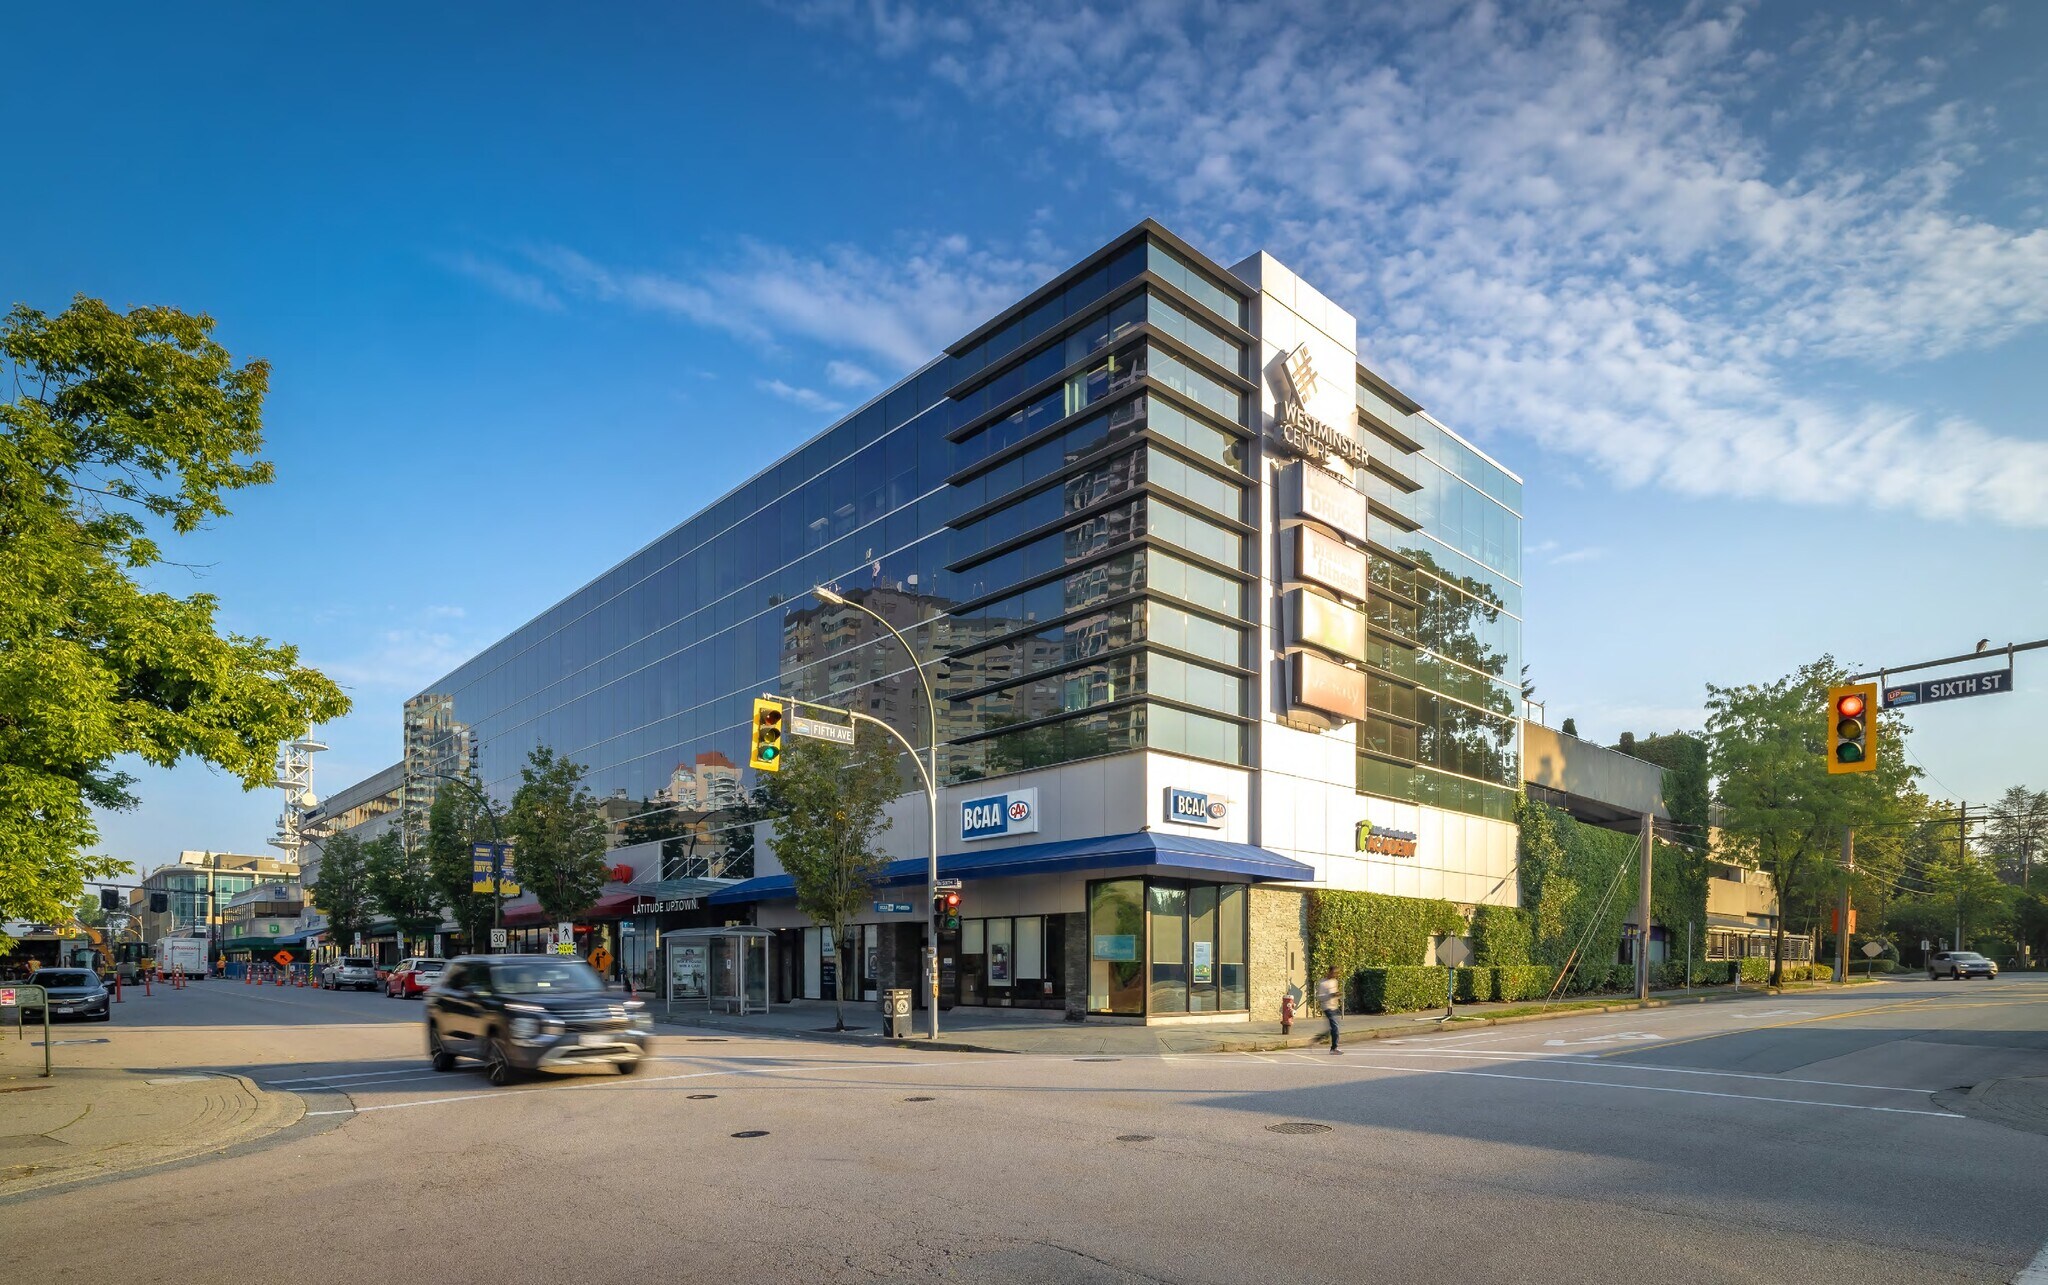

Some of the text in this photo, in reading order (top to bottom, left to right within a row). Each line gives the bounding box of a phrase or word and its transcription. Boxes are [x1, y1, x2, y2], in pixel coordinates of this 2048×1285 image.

[1284, 401, 1369, 466] WESTMINSTER
[1283, 424, 1333, 461] CENTRE
[1889, 690, 1901, 699] UP
[1930, 674, 2002, 698] SIXTH ST
[813, 724, 835, 738] FIFTH
[837, 727, 852, 741] AVE
[1010, 803, 1026, 818] CAA
[1178, 795, 1206, 817] BCAA
[1212, 804, 1224, 816] CAA
[964, 803, 1001, 831] BCAA
[1366, 835, 1417, 857] ACADEMY
[473, 865, 487, 873] DAY
[632, 899, 697, 914] LATITUDE UPTOWN
[492, 933, 505, 943] 30
